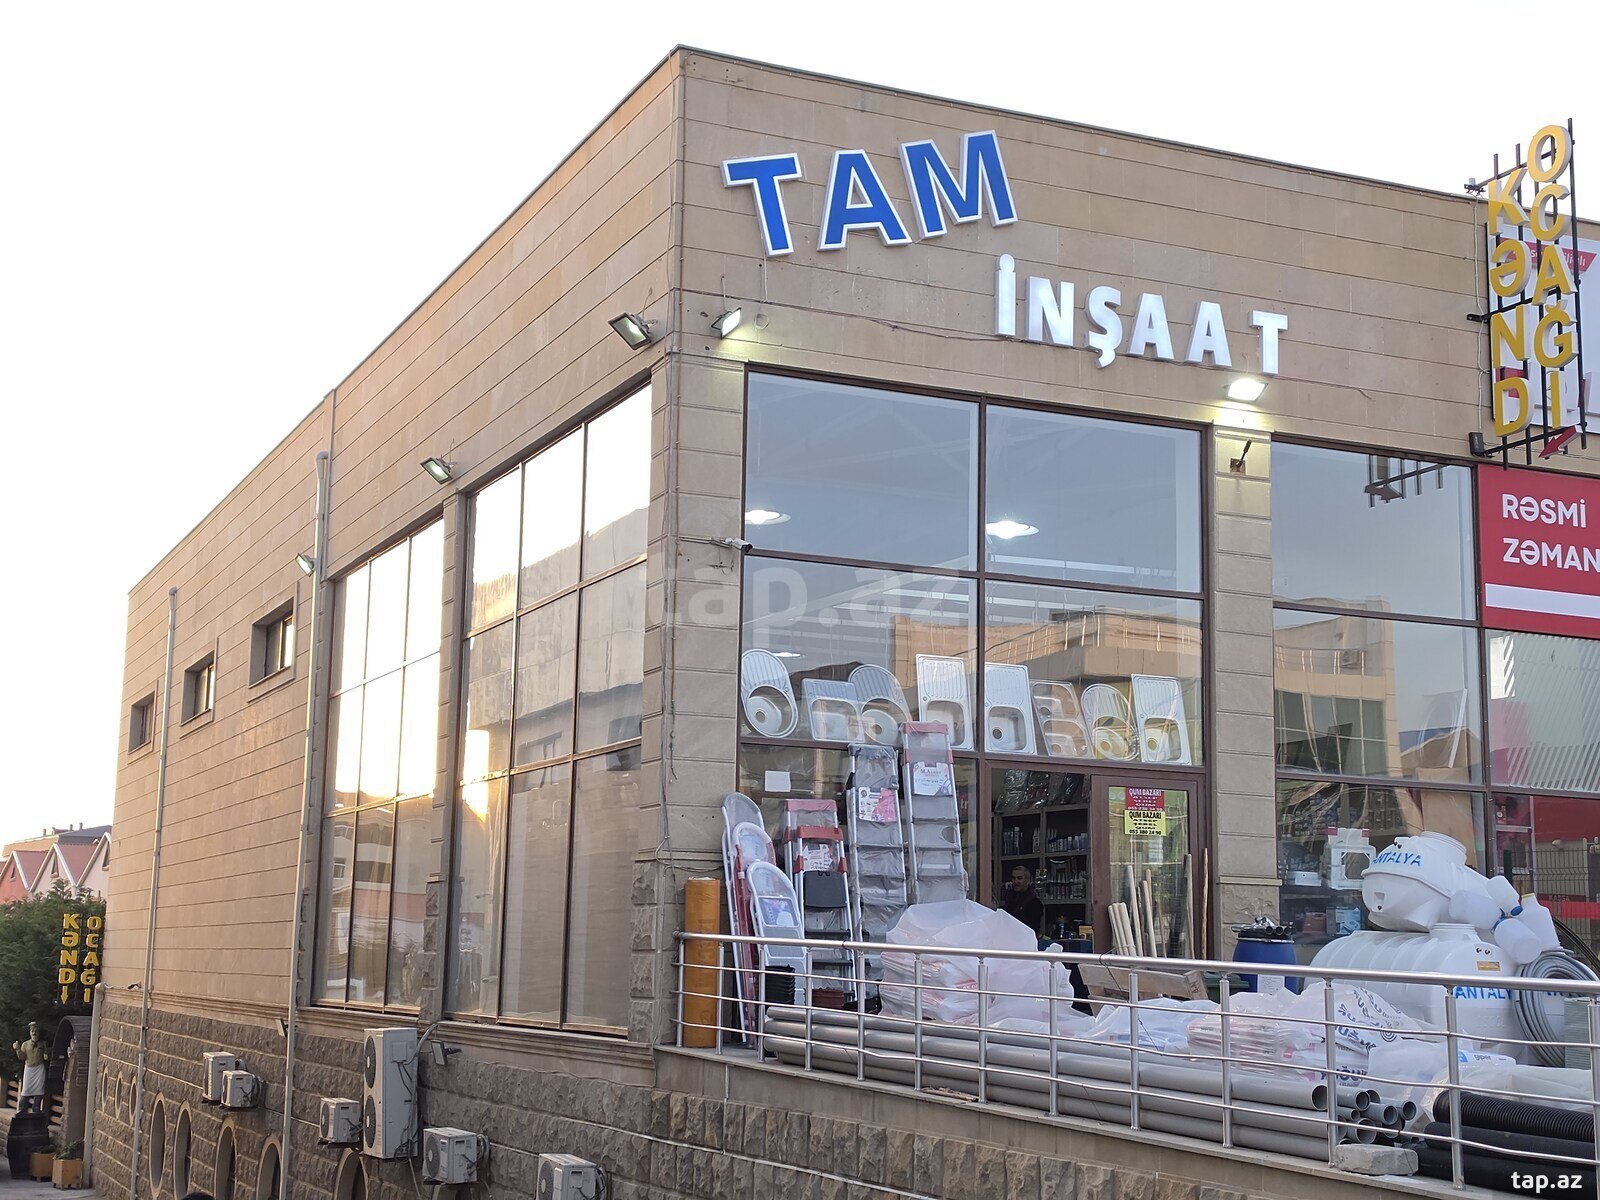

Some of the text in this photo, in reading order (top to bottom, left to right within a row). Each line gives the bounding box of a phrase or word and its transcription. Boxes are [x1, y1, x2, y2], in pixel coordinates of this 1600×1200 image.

[720, 129, 1018, 257] TAM
[994, 254, 1288, 375] İNŞAAT
[1488, 168, 1533, 437] KƏND
[1527, 125, 1579, 429] OCAĞI
[1502, 493, 1587, 528] RƏSMİ
[1129, 811, 1141, 819] QUM
[59, 913, 80, 984] KƏND
